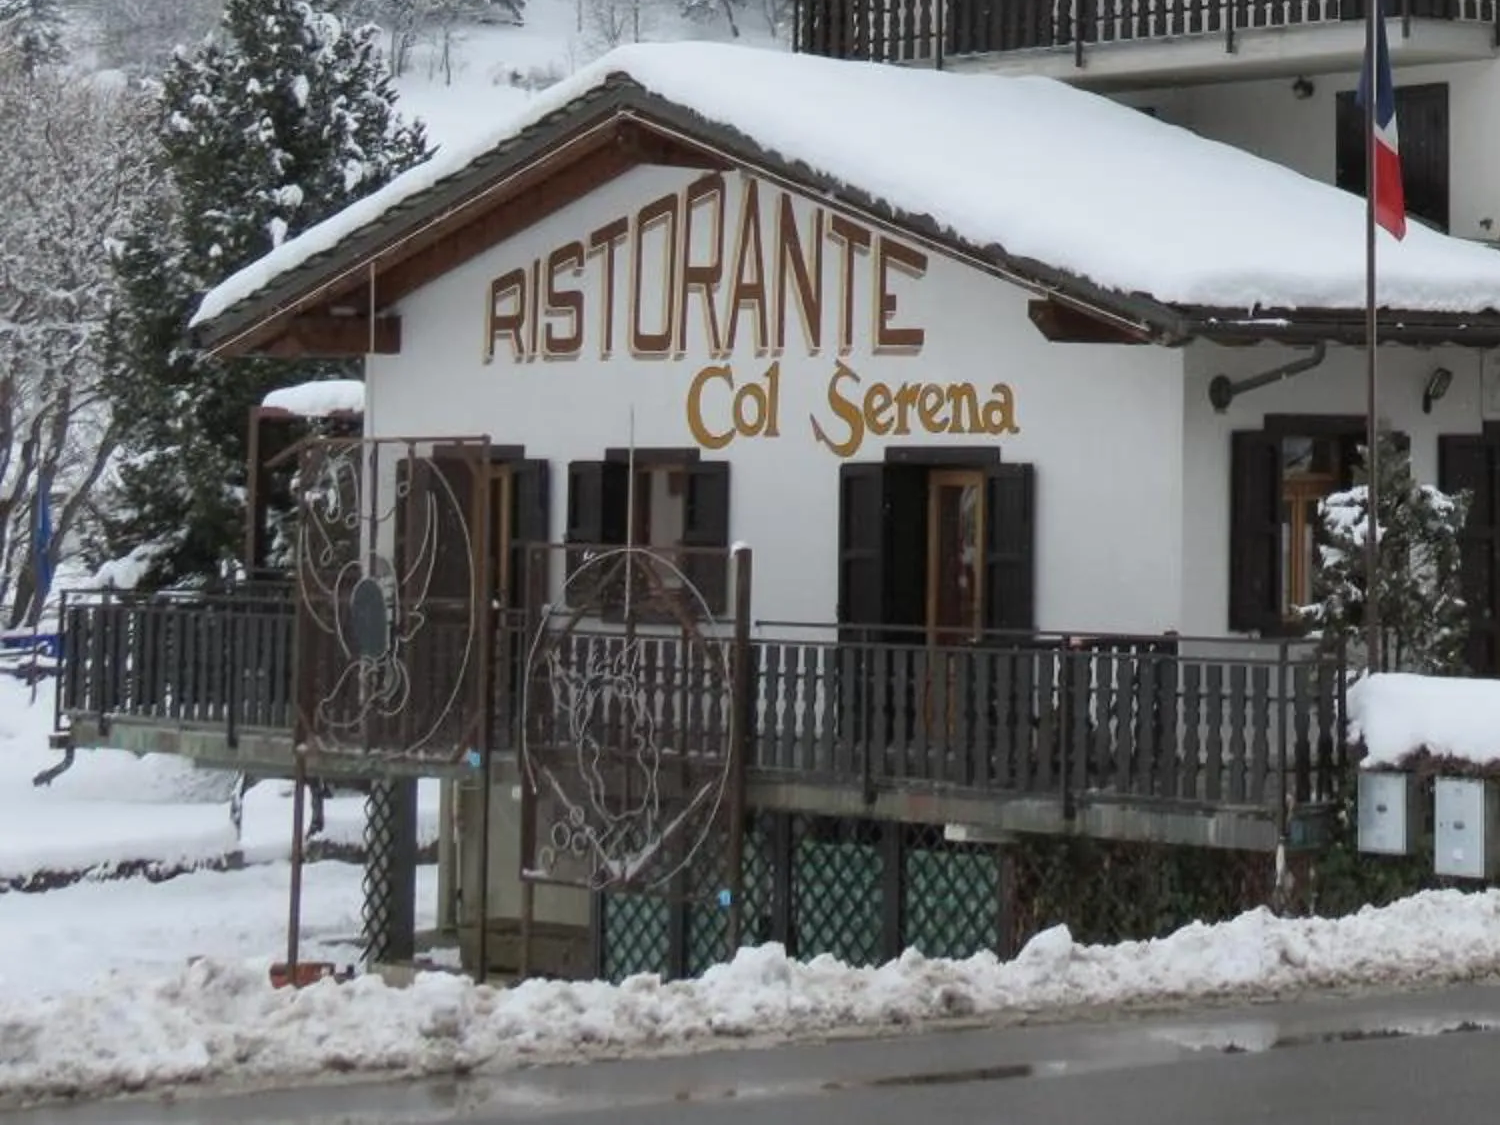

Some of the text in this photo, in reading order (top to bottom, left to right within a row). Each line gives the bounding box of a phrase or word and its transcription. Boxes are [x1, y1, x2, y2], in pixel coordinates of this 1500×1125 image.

[483, 173, 928, 364] RISTORANTE
[686, 359, 1020, 458] Col Serena
